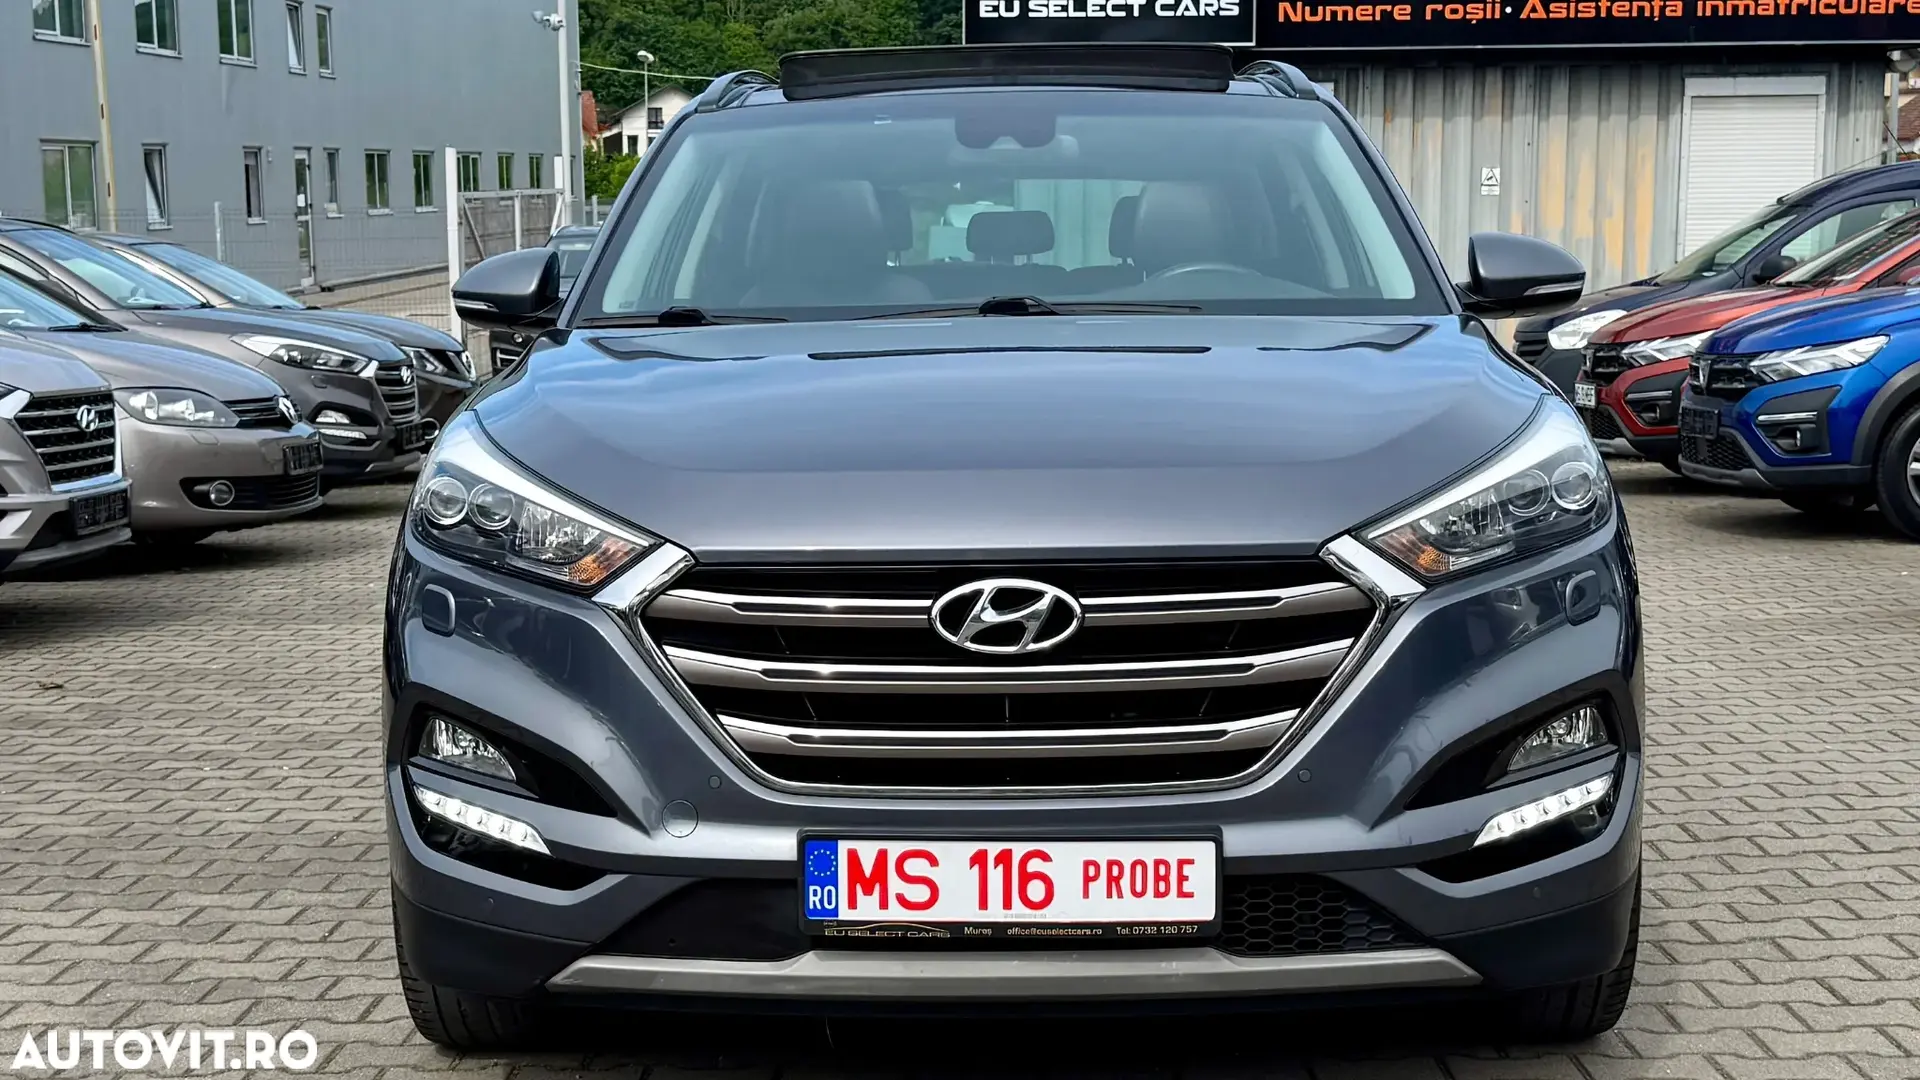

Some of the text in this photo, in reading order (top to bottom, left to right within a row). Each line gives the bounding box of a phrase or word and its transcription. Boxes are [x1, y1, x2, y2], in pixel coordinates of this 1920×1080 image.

[980, 0, 1240, 17] EU SELECT CARS
[1278, 1, 1412, 22] Numere
[847, 848, 1195, 911] MS 116 PROBE
[809, 885, 837, 910] RO
[1132, 926, 1157, 935] 0732
[1160, 926, 1178, 935] 120
[1180, 925, 1198, 934] 757
